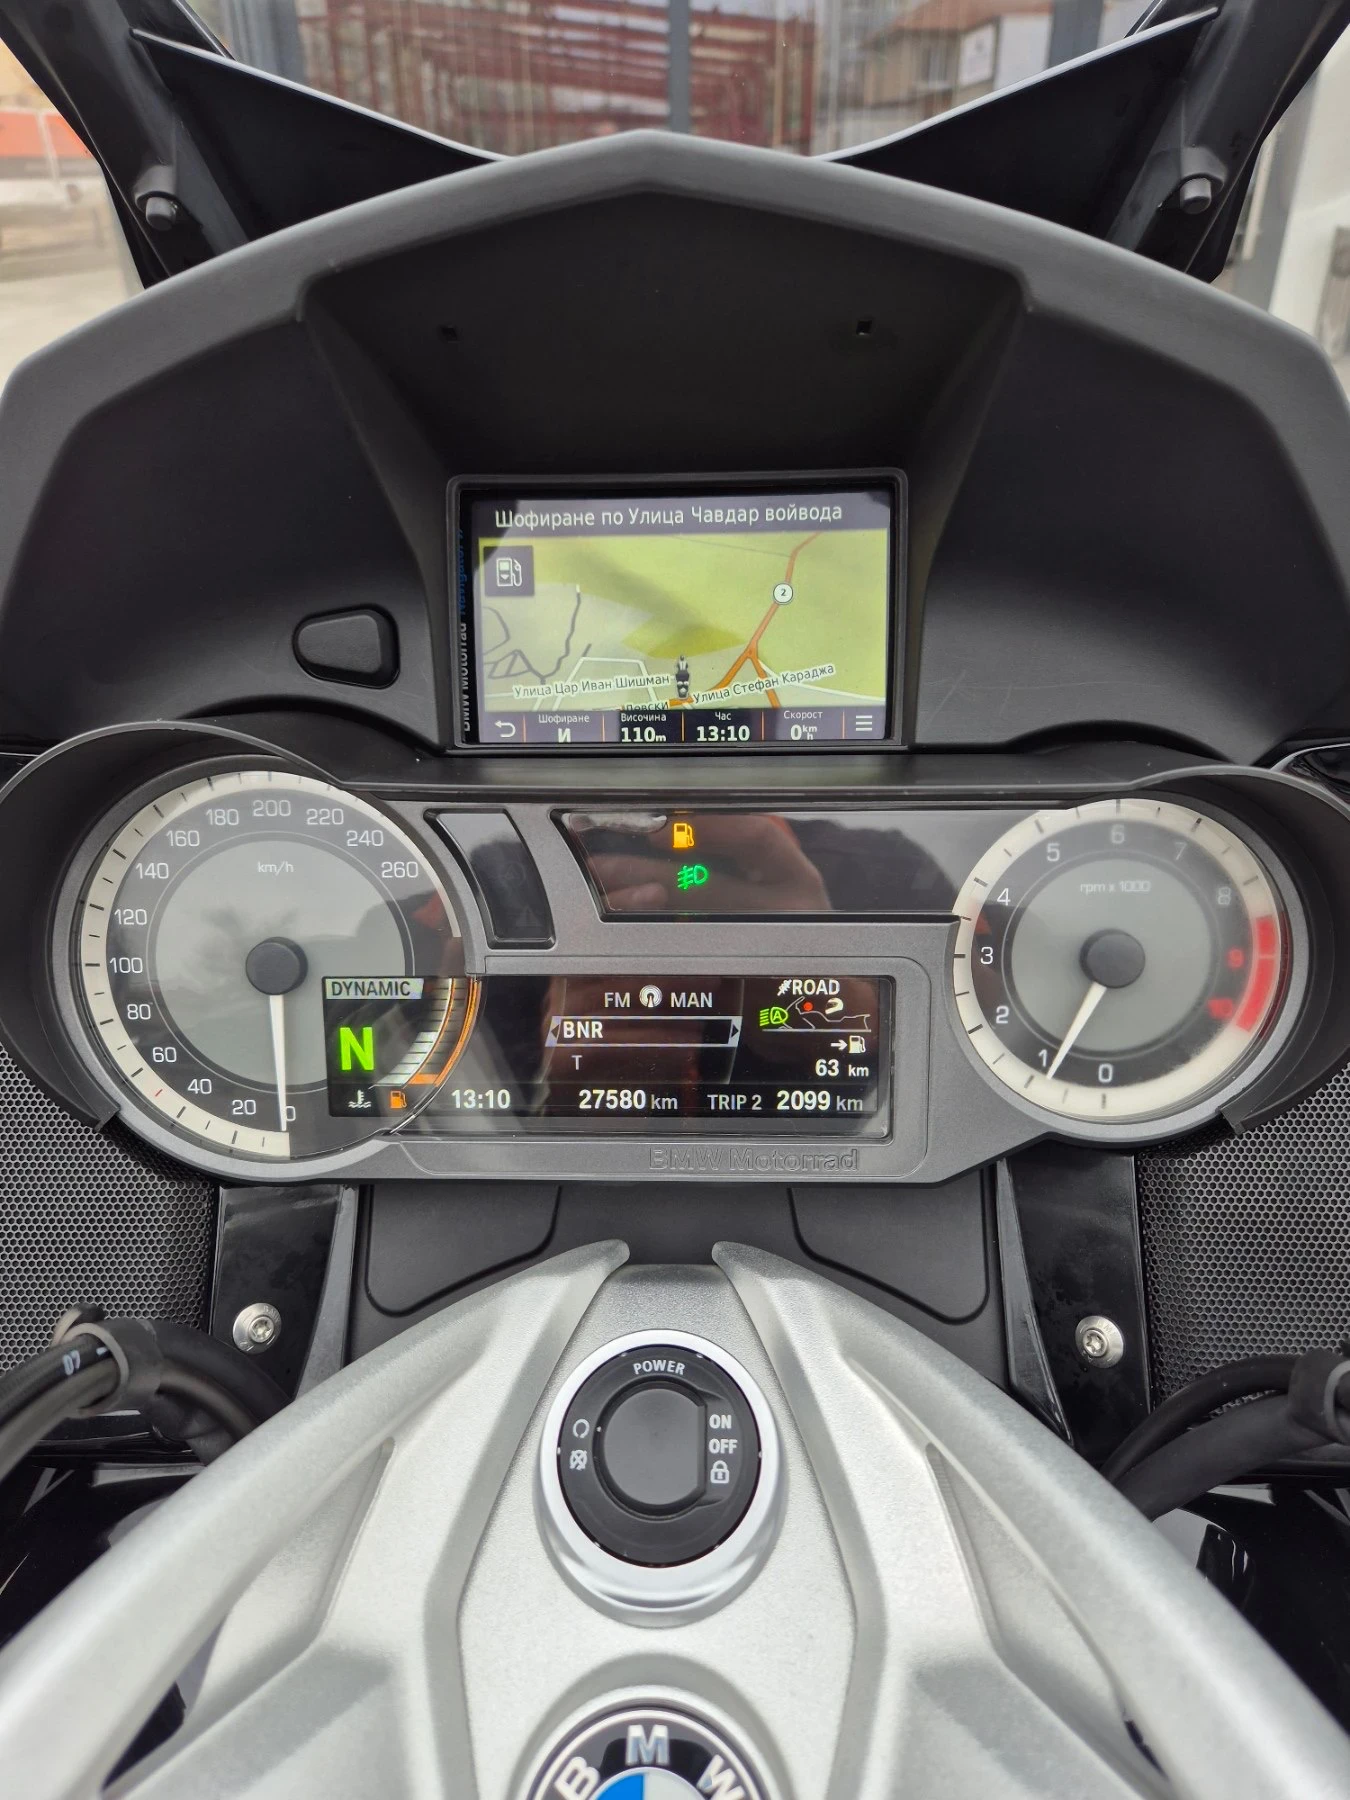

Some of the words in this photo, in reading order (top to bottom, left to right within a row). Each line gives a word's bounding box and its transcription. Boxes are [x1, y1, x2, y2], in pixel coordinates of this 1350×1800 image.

[495, 510, 595, 531] Шофиране
[602, 512, 624, 525] по
[628, 507, 684, 526] Улица
[691, 506, 760, 525] Чавдар
[765, 504, 842, 523] войвода
[780, 588, 787, 597] 2
[514, 686, 552, 698] Улица
[555, 683, 578, 696] Цар
[582, 680, 612, 692] Иван
[615, 675, 670, 689] Шишман
[693, 689, 730, 704] Улица
[733, 677, 780, 695] Стефан
[782, 664, 834, 684] Караджа
[538, 714, 590, 724] Шофиране
[621, 713, 667, 722] Височина
[714, 711, 732, 721] Час
[783, 710, 823, 720] Скорост
[696, 725, 751, 742] 13:10
[205, 808, 240, 826] 180
[252, 799, 291, 817] 200
[306, 808, 344, 826] 220
[166, 830, 200, 847] 160
[346, 829, 384, 847] 240
[1111, 826, 1125, 844] 6
[1046, 843, 1060, 862] 5
[1174, 842, 1188, 860] 7
[135, 862, 169, 880] 140
[257, 861, 294, 875] km/h
[381, 861, 419, 879] 260
[996, 888, 1011, 906] 4
[1080, 883, 1105, 896] rpm
[114, 908, 147, 926] 120
[980, 946, 994, 965] 3
[109, 957, 143, 974] 100
[331, 981, 411, 997] DYNAMIC
[792, 979, 840, 995] ROAD
[604, 992, 631, 1008] FM
[670, 992, 713, 1008] MAN
[127, 1004, 152, 1021] 80
[995, 1006, 1009, 1024] 2
[563, 1021, 603, 1039] BNR
[152, 1046, 177, 1063] 60
[339, 1026, 374, 1070] N
[571, 1055, 583, 1070] T
[1038, 1049, 1048, 1067] 1
[815, 1059, 840, 1077] 63
[848, 1064, 869, 1077] km
[1098, 1064, 1113, 1083] 0
[187, 1078, 212, 1095] 40
[232, 1100, 257, 1116] 20
[451, 1089, 511, 1109] 13:10
[578, 1089, 647, 1110] 27580
[650, 1095, 678, 1110] km
[707, 1094, 747, 1110] TRIP
[751, 1095, 762, 1110] 2
[777, 1090, 830, 1111] 2099
[836, 1096, 863, 1112] km
[649, 1148, 723, 1170] BMW
[729, 1148, 859, 1172] Motorrad
[633, 1359, 686, 1375] POWER
[709, 1414, 732, 1429] ON
[708, 1438, 738, 1454] OFF
[553, 1724, 745, 1800] BMW
